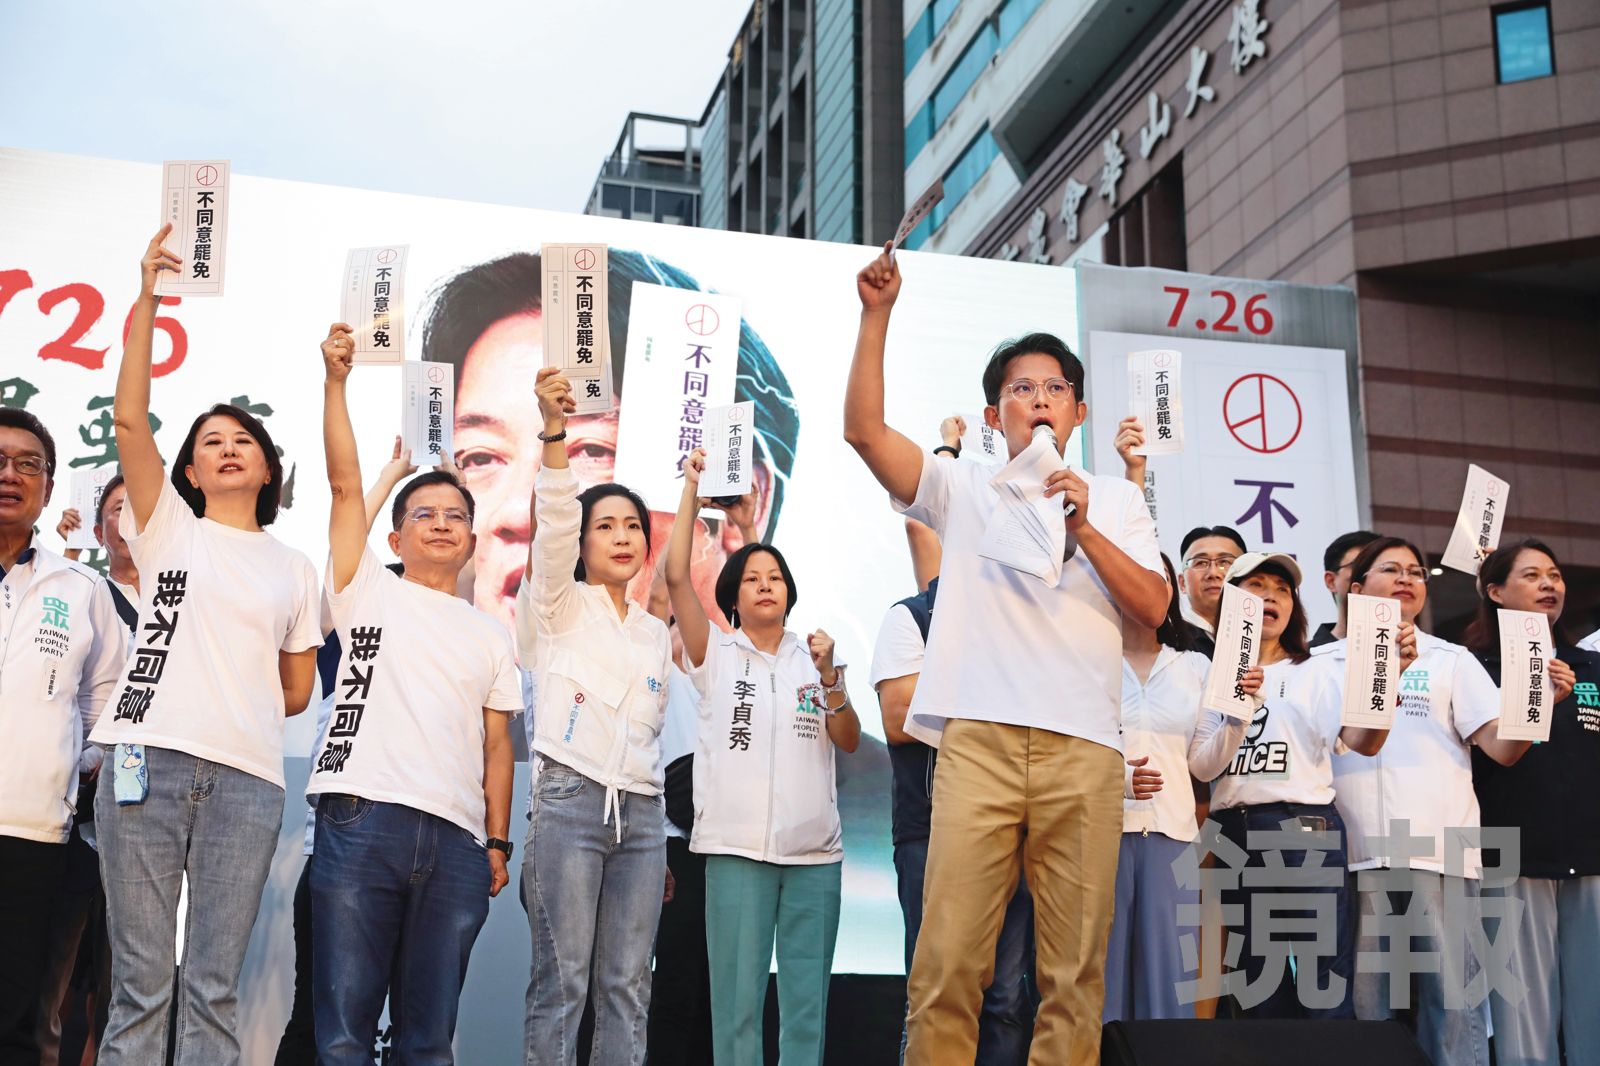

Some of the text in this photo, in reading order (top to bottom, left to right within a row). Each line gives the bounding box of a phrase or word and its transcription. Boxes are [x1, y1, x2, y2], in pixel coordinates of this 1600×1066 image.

[192, 191, 215, 279] 不同意罷免
[373, 267, 392, 348] 不同意罷免
[576, 275, 594, 365] 不同意罷免
[1163, 286, 1274, 336] 7.26
[585, 379, 602, 398] 免
[1155, 370, 1172, 441] 不同意罷免
[428, 386, 443, 456] 不同意罷免
[727, 423, 743, 484] 不同意罷免
[39, 627, 70, 643] TAIWAN
[40, 596, 70, 632] 眾
[34, 636, 69, 652] PEOPLE'S
[39, 646, 65, 659] PARTY
[113, 569, 188, 724] 我不同意
[1370, 627, 1390, 712] 不同意罷免
[315, 626, 383, 775] 我不同意
[1402, 669, 1431, 693] 眾
[1527, 640, 1544, 724] 不同意罷免
[729, 680, 757, 752] 李貞秀
[795, 716, 820, 725] TAIWAN
[797, 732, 818, 740] PARTY
[1405, 710, 1429, 718] PARTY
[1226, 741, 1288, 775] TICE
